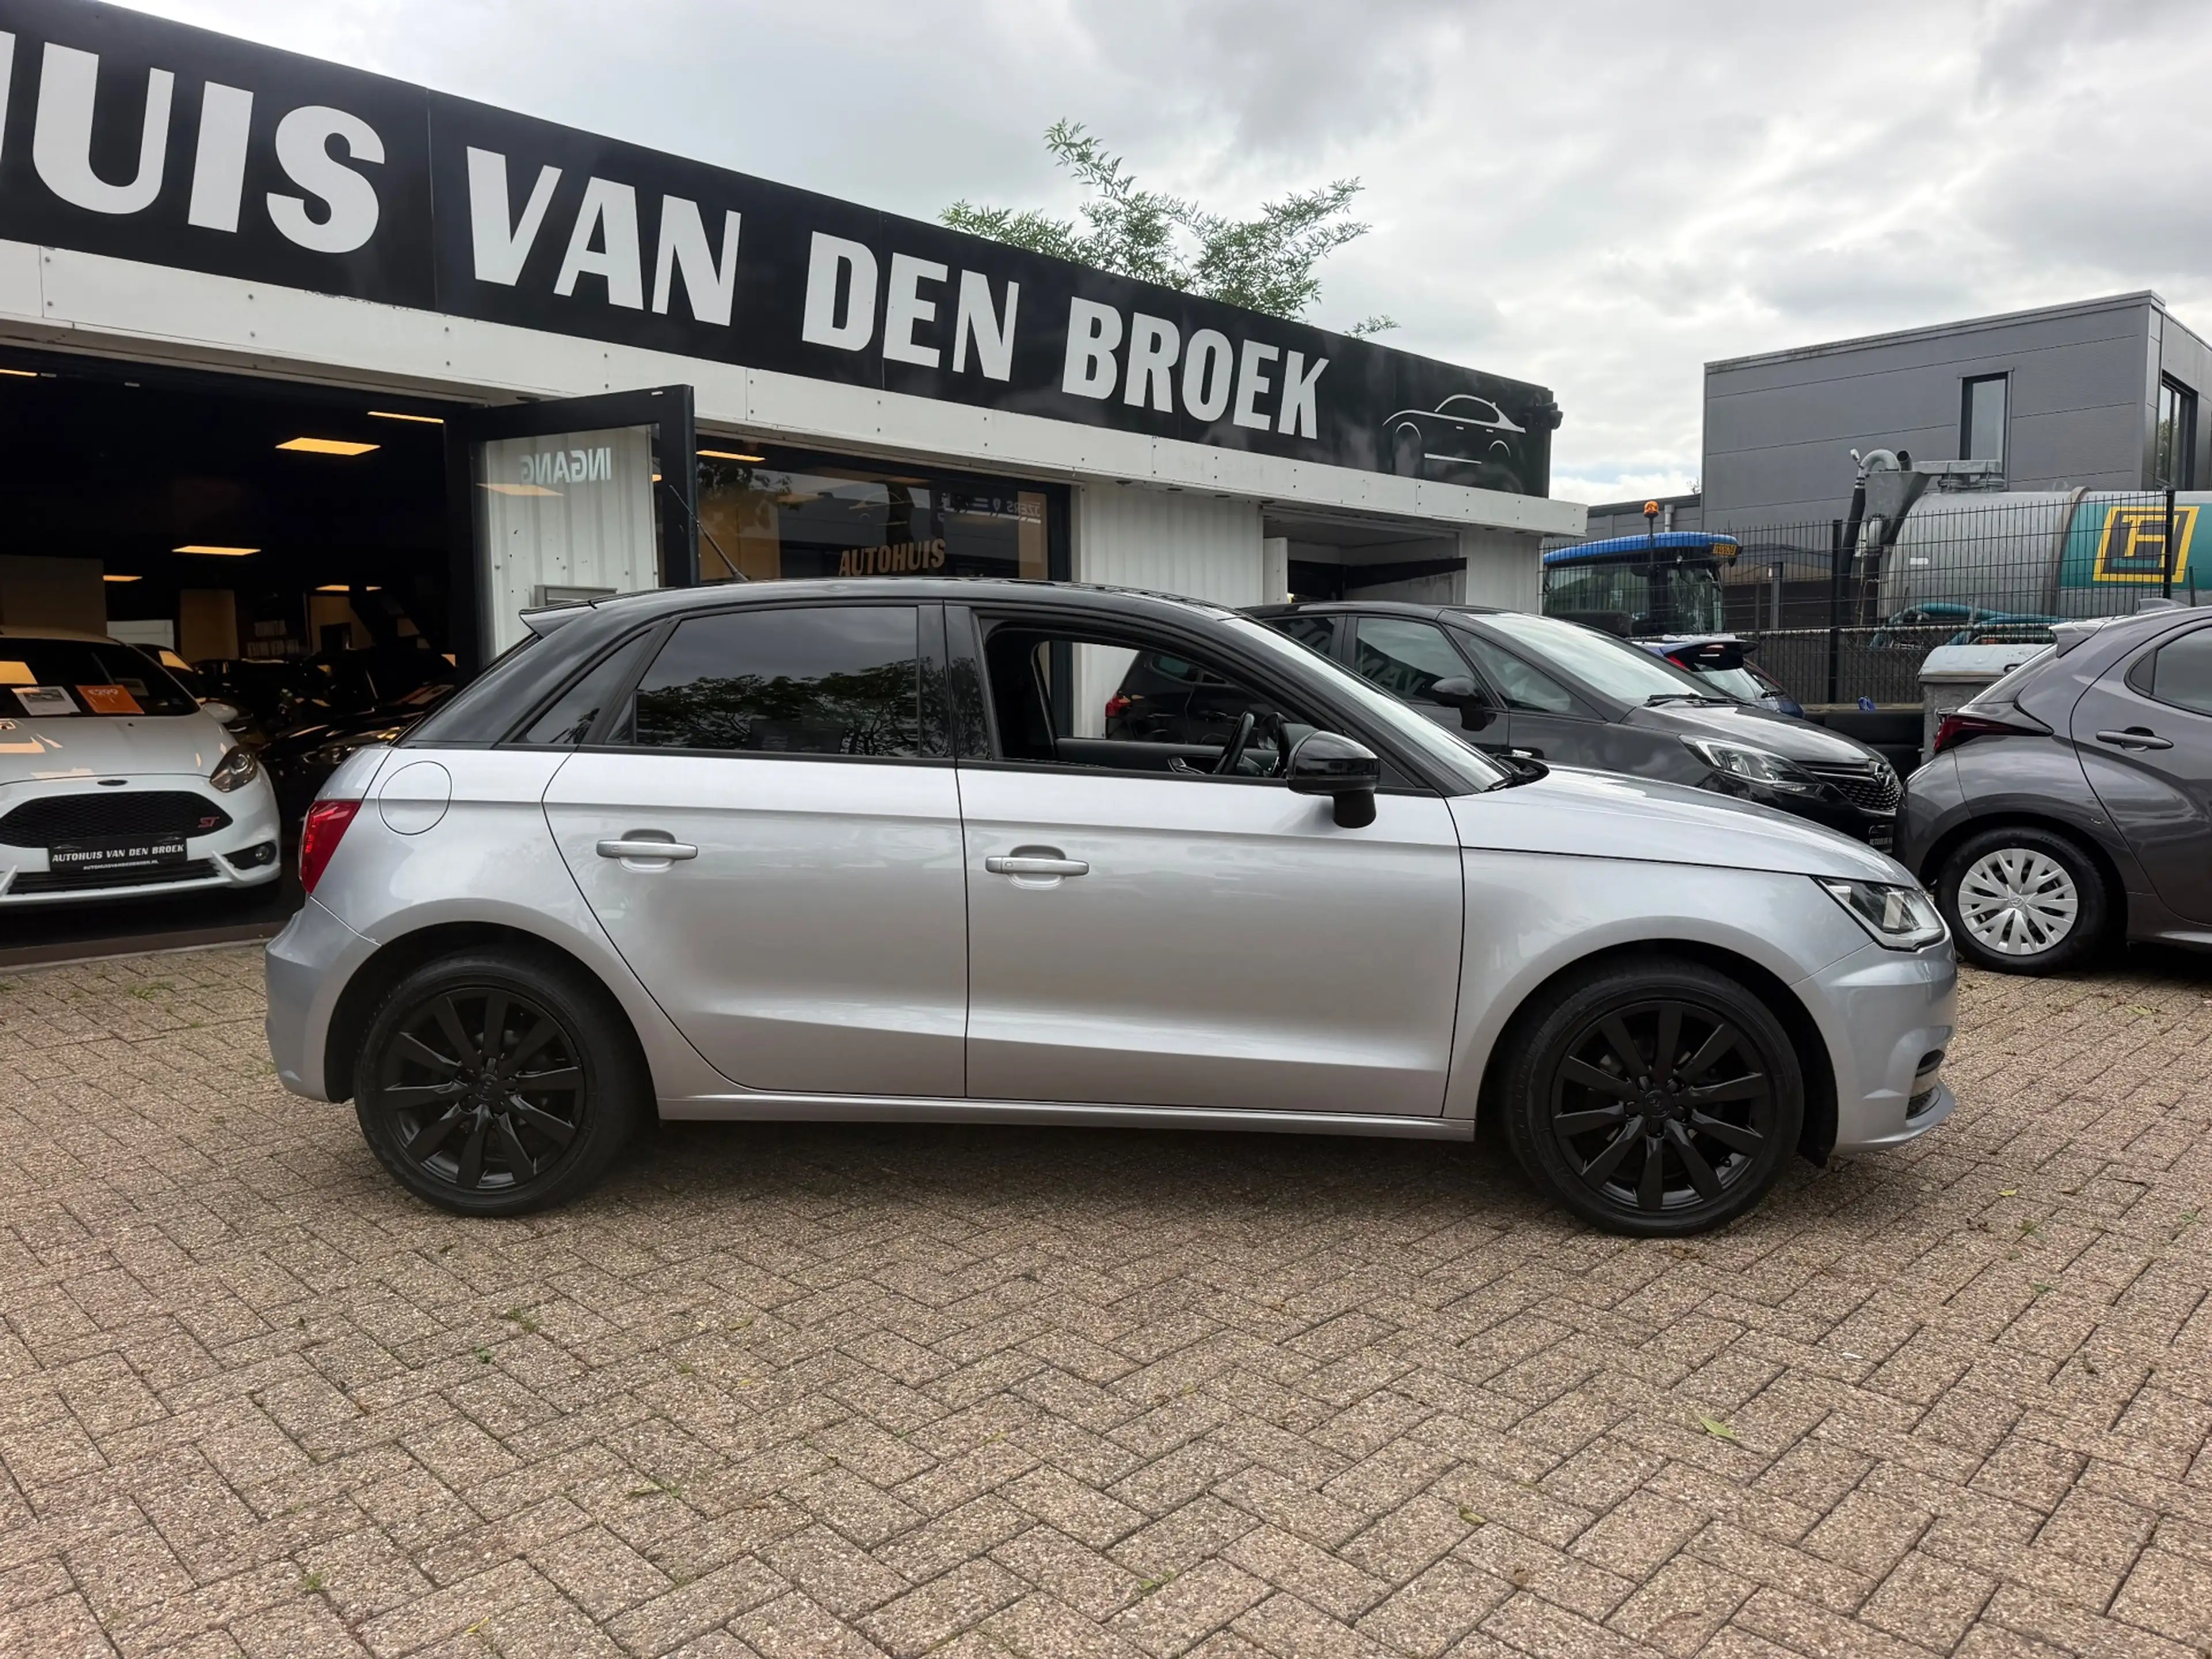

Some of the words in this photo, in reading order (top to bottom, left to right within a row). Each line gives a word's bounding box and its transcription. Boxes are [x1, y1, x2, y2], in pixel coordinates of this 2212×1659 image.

[0, 31, 384, 253] UIS
[467, 146, 741, 326] VAN
[802, 231, 1020, 382] DEN
[1062, 296, 1329, 440] BROEK
[839, 538, 945, 576] AUTOHUIS
[198, 816, 220, 828] ST
[52, 851, 103, 862] AUTOHUIS
[107, 849, 125, 858] VAN
[129, 848, 149, 856] DEN
[152, 844, 184, 854] BROEK
